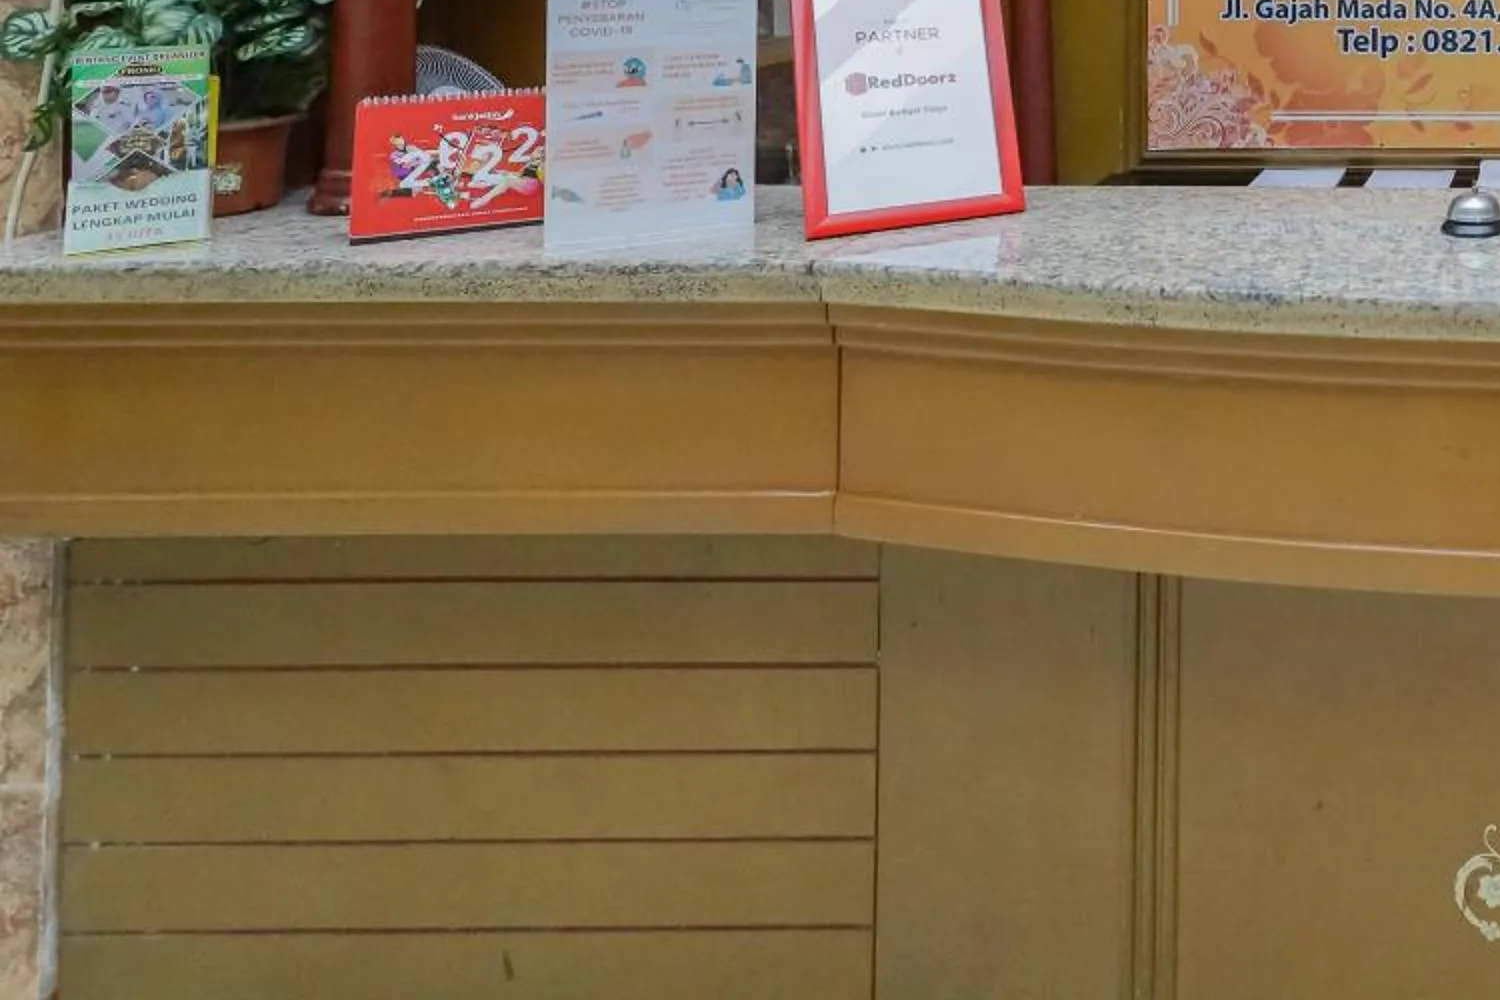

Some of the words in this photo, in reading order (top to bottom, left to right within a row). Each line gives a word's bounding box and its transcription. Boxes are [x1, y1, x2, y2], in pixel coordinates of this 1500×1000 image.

[1415, 0, 1456, 20] No.
[855, 27, 940, 43] PARTNER
[1337, 28, 1398, 59] Telp
[867, 72, 957, 89] RedDoorz
[72, 201, 119, 215] PAKET
[125, 192, 198, 209] WEDDING
[72, 214, 143, 231] LENGKAP
